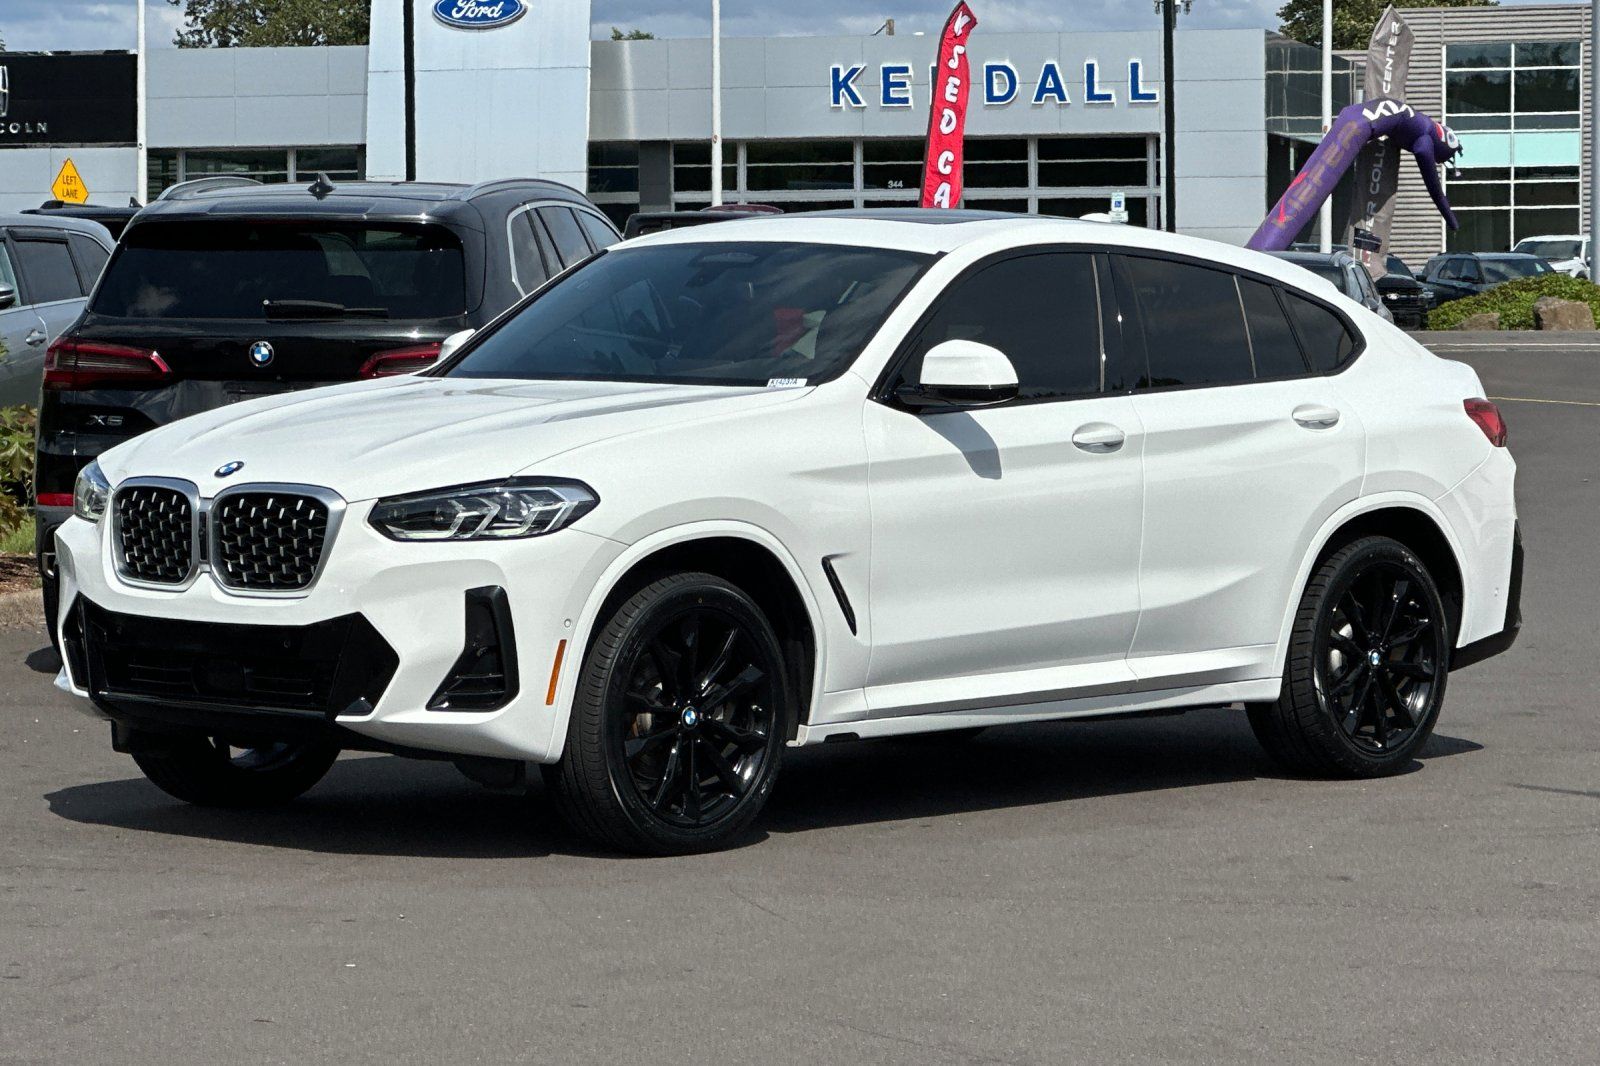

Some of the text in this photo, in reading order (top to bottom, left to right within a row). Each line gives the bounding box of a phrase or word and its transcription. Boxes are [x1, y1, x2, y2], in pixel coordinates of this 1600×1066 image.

[451, 0, 504, 18] Ford
[1382, 20, 1403, 95] CENTER
[829, 58, 1160, 108] KEDALL
[62, 175, 77, 186] LEFT
[933, 150, 954, 208] CA
[1271, 119, 1361, 230] KIEFER
[62, 188, 79, 199] LANE
[887, 180, 904, 189] 344
[86, 415, 124, 427] X5
